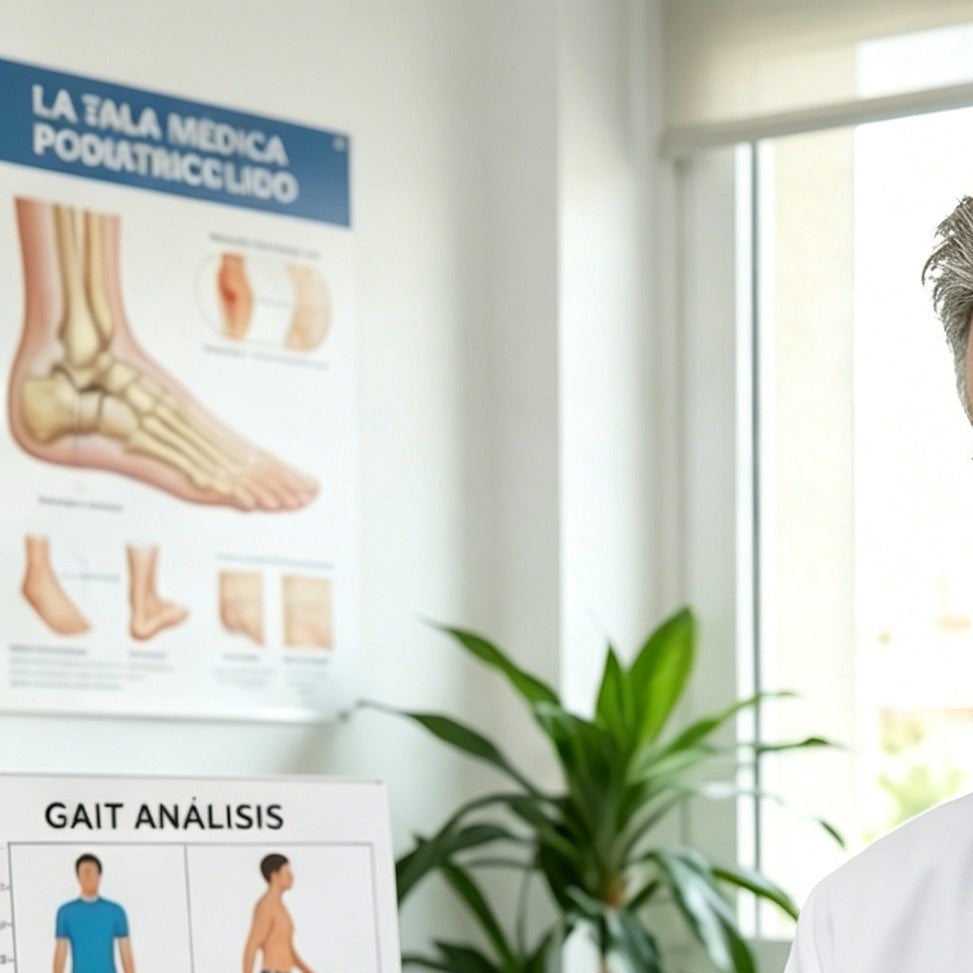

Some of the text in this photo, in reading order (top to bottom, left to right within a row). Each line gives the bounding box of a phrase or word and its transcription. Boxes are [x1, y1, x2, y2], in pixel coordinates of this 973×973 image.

[32, 84, 78, 124] LA
[44, 796, 285, 831] GAIT ANÁLISIS
